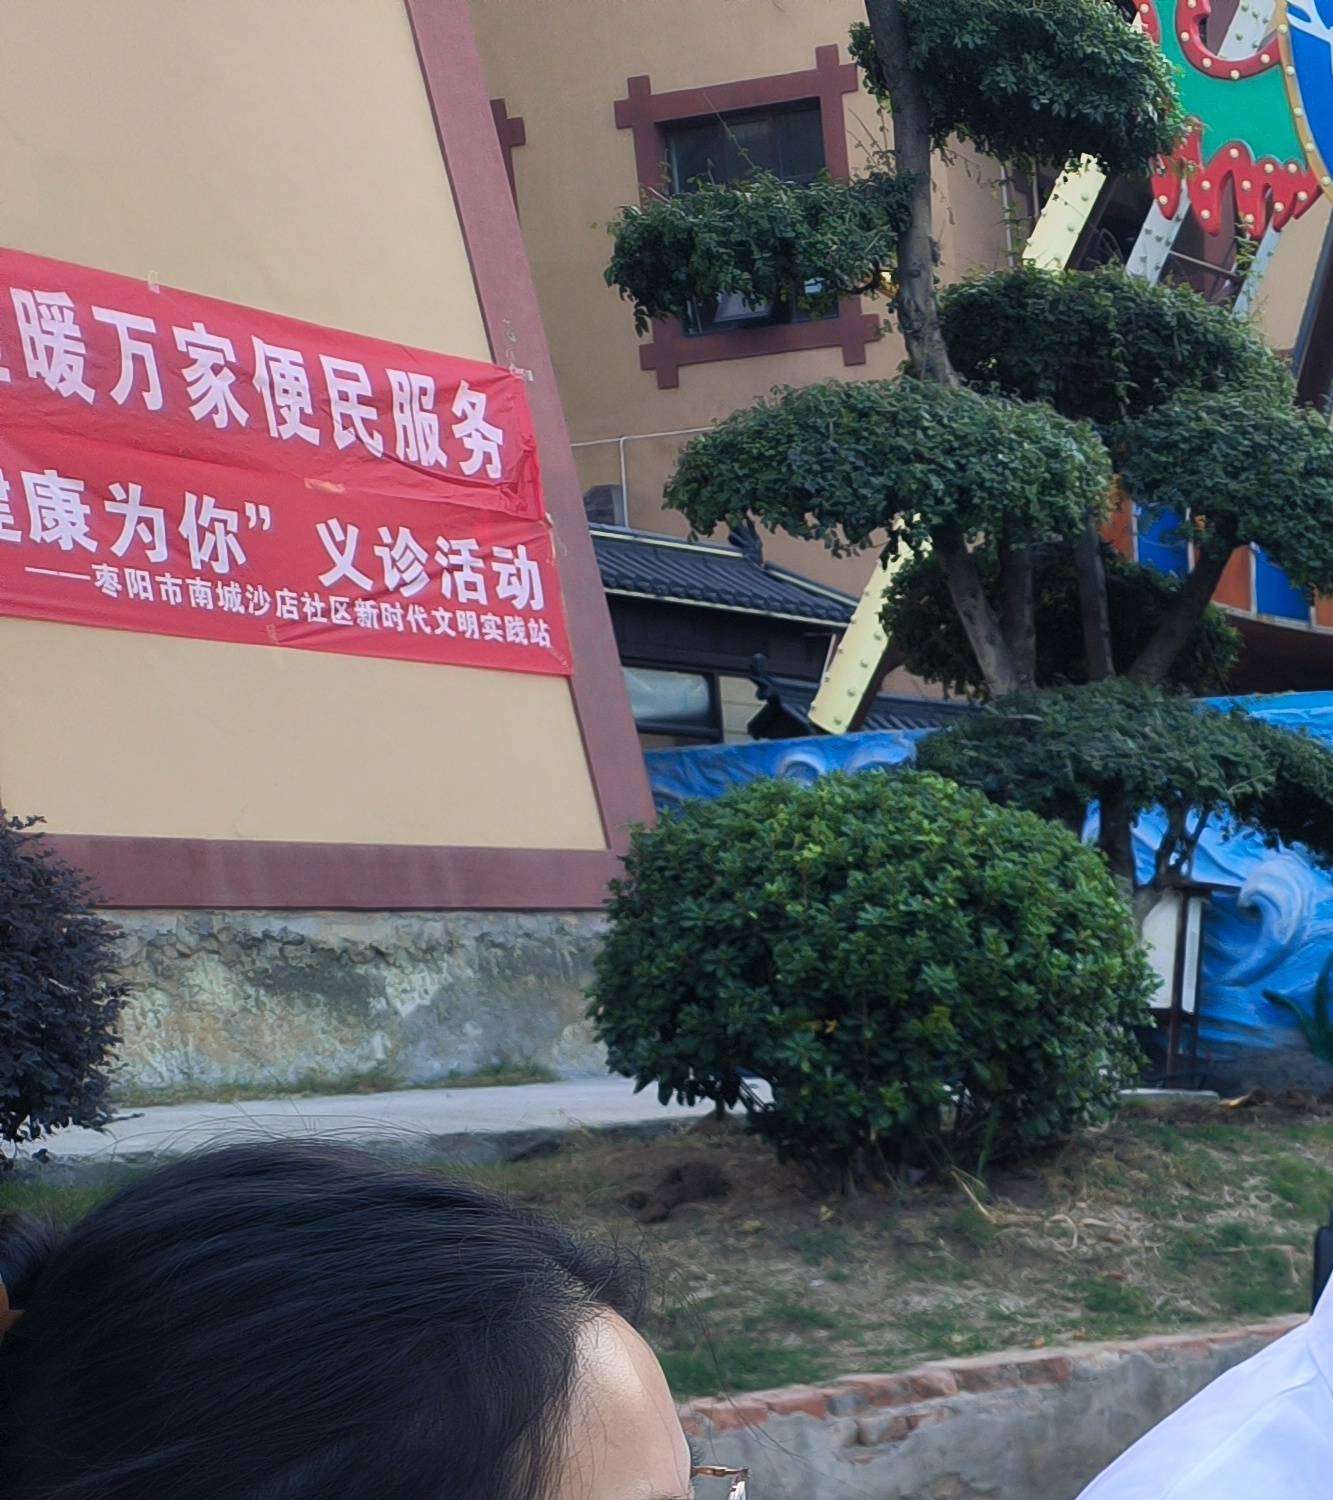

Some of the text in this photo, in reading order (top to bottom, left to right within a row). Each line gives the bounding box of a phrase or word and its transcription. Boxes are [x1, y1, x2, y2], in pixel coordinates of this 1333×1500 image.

[0, 286, 504, 479] 暖万家便民服务
[315, 517, 546, 612] 义诊活动
